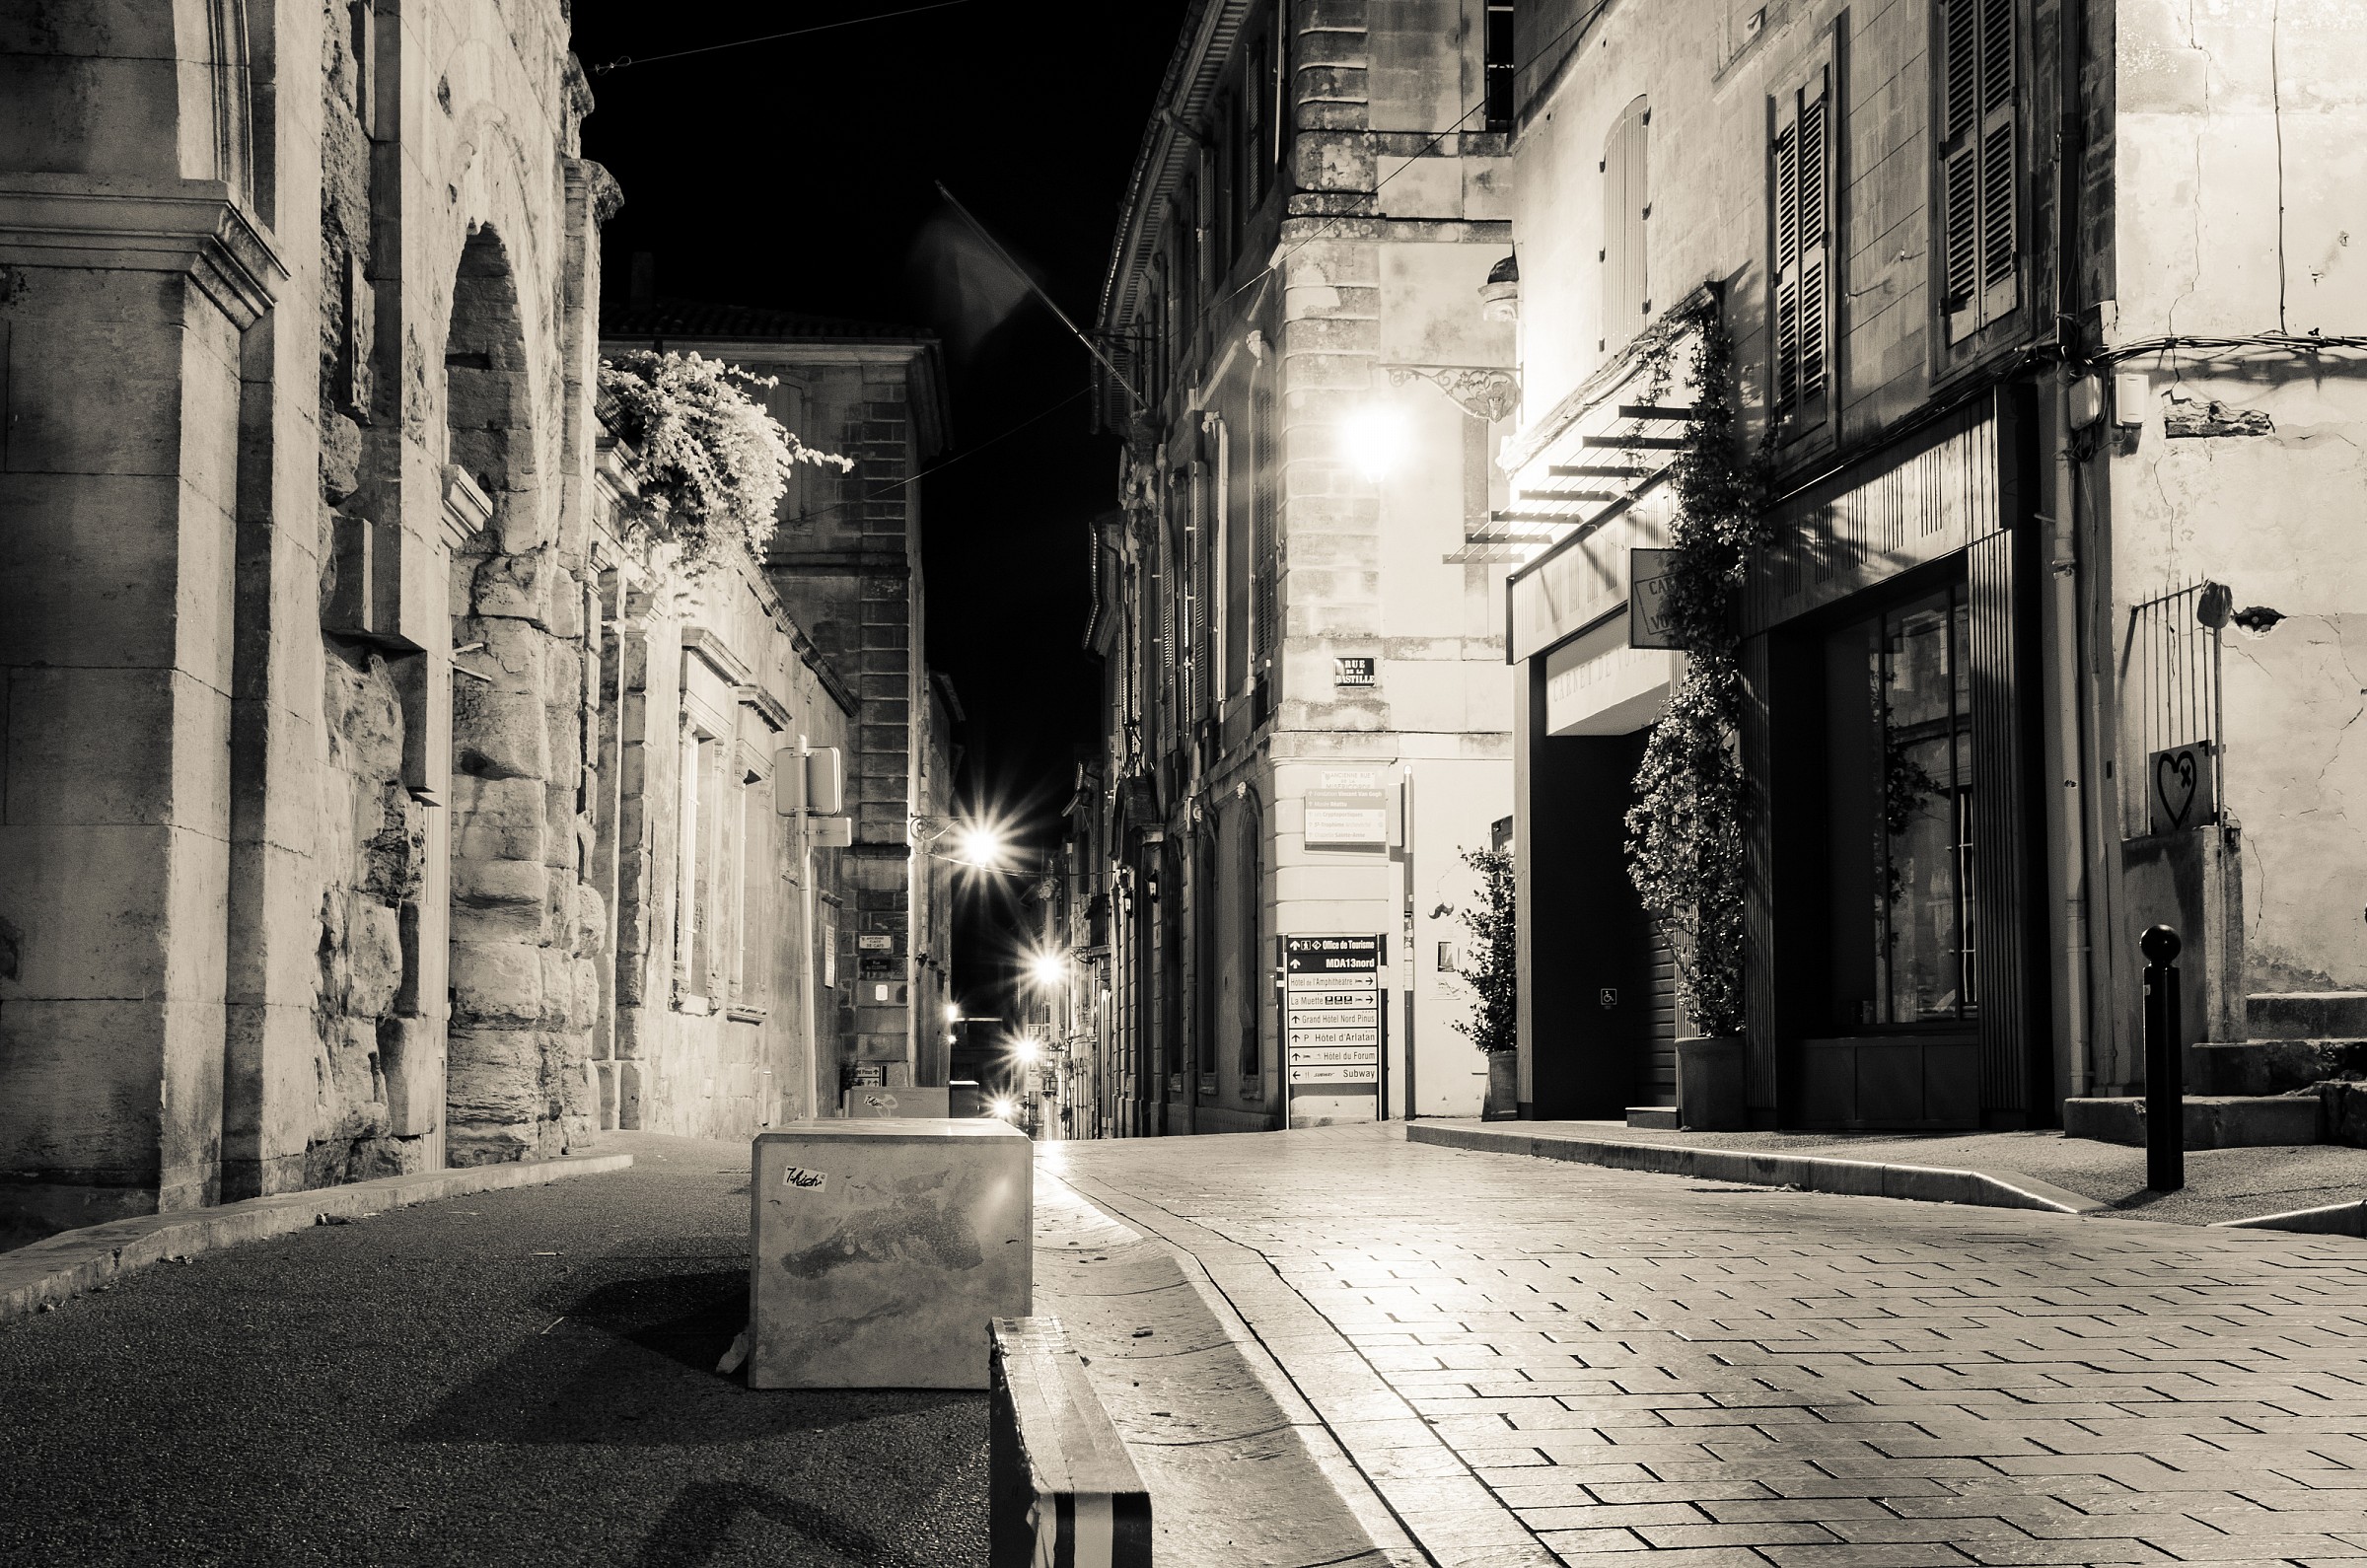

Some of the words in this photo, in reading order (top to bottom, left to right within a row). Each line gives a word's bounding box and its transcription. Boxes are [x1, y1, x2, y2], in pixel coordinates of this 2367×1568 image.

[1344, 660, 1366, 669] RUE
[1335, 675, 1375, 683] BASTILLE
[1322, 940, 1339, 950] Office
[1339, 940, 1348, 950] de
[1348, 940, 1375, 950] Tourisme
[1326, 958, 1375, 968] MDA13nord
[1290, 996, 1298, 1006] La
[1301, 996, 1324, 1006] Muette
[1302, 1014, 1321, 1024] Grand
[1323, 1014, 1339, 1024] Hôtel
[1340, 1014, 1356, 1023] Nord
[1357, 1014, 1375, 1023] Pinus
[1304, 1033, 1310, 1042] P
[1315, 1033, 1336, 1042] Hôtel
[1338, 1033, 1375, 1042] d'Arlatan
[1324, 1051, 1341, 1061] Hôtel
[1342, 1051, 1352, 1060] du
[1353, 1051, 1376, 1060] Forum
[1342, 1068, 1376, 1080] Subway
